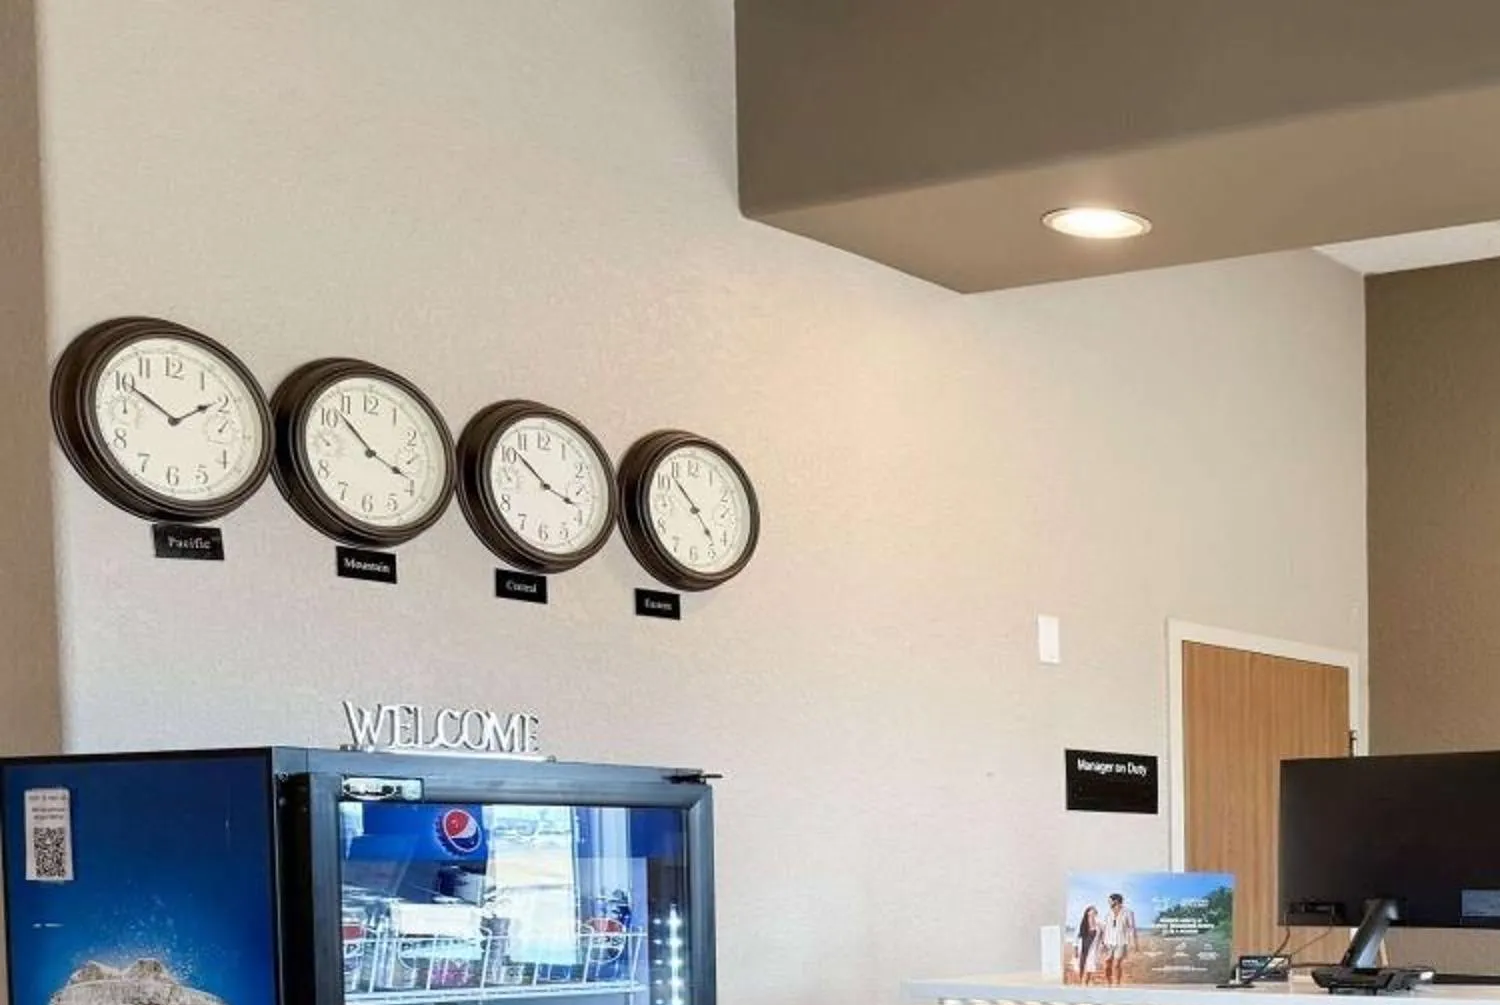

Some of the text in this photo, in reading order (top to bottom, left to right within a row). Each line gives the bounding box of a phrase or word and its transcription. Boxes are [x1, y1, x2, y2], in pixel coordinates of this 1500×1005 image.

[139, 356, 151, 379] 11
[165, 356, 184, 380] 12
[115, 370, 135, 392] 10
[217, 395, 229, 414] 2
[341, 394, 352, 415] 11
[363, 394, 379, 415] 12
[320, 407, 338, 428] 10
[113, 428, 127, 449] 8
[406, 430, 417, 447] 2
[137, 453, 151, 473] 7
[214, 450, 230, 469] 4
[317, 459, 329, 480] 8
[166, 466, 180, 486] 6
[195, 466, 209, 485] 5
[337, 481, 349, 501] 7
[404, 479, 415, 497] 4
[361, 495, 374, 513] 6
[386, 493, 398, 511] 5
[168, 536, 212, 550] Pacific
[344, 557, 391, 573] Mountain
[342, 700, 539, 753] WELCOME
[1077, 758, 1147, 777] Manager on Duty
